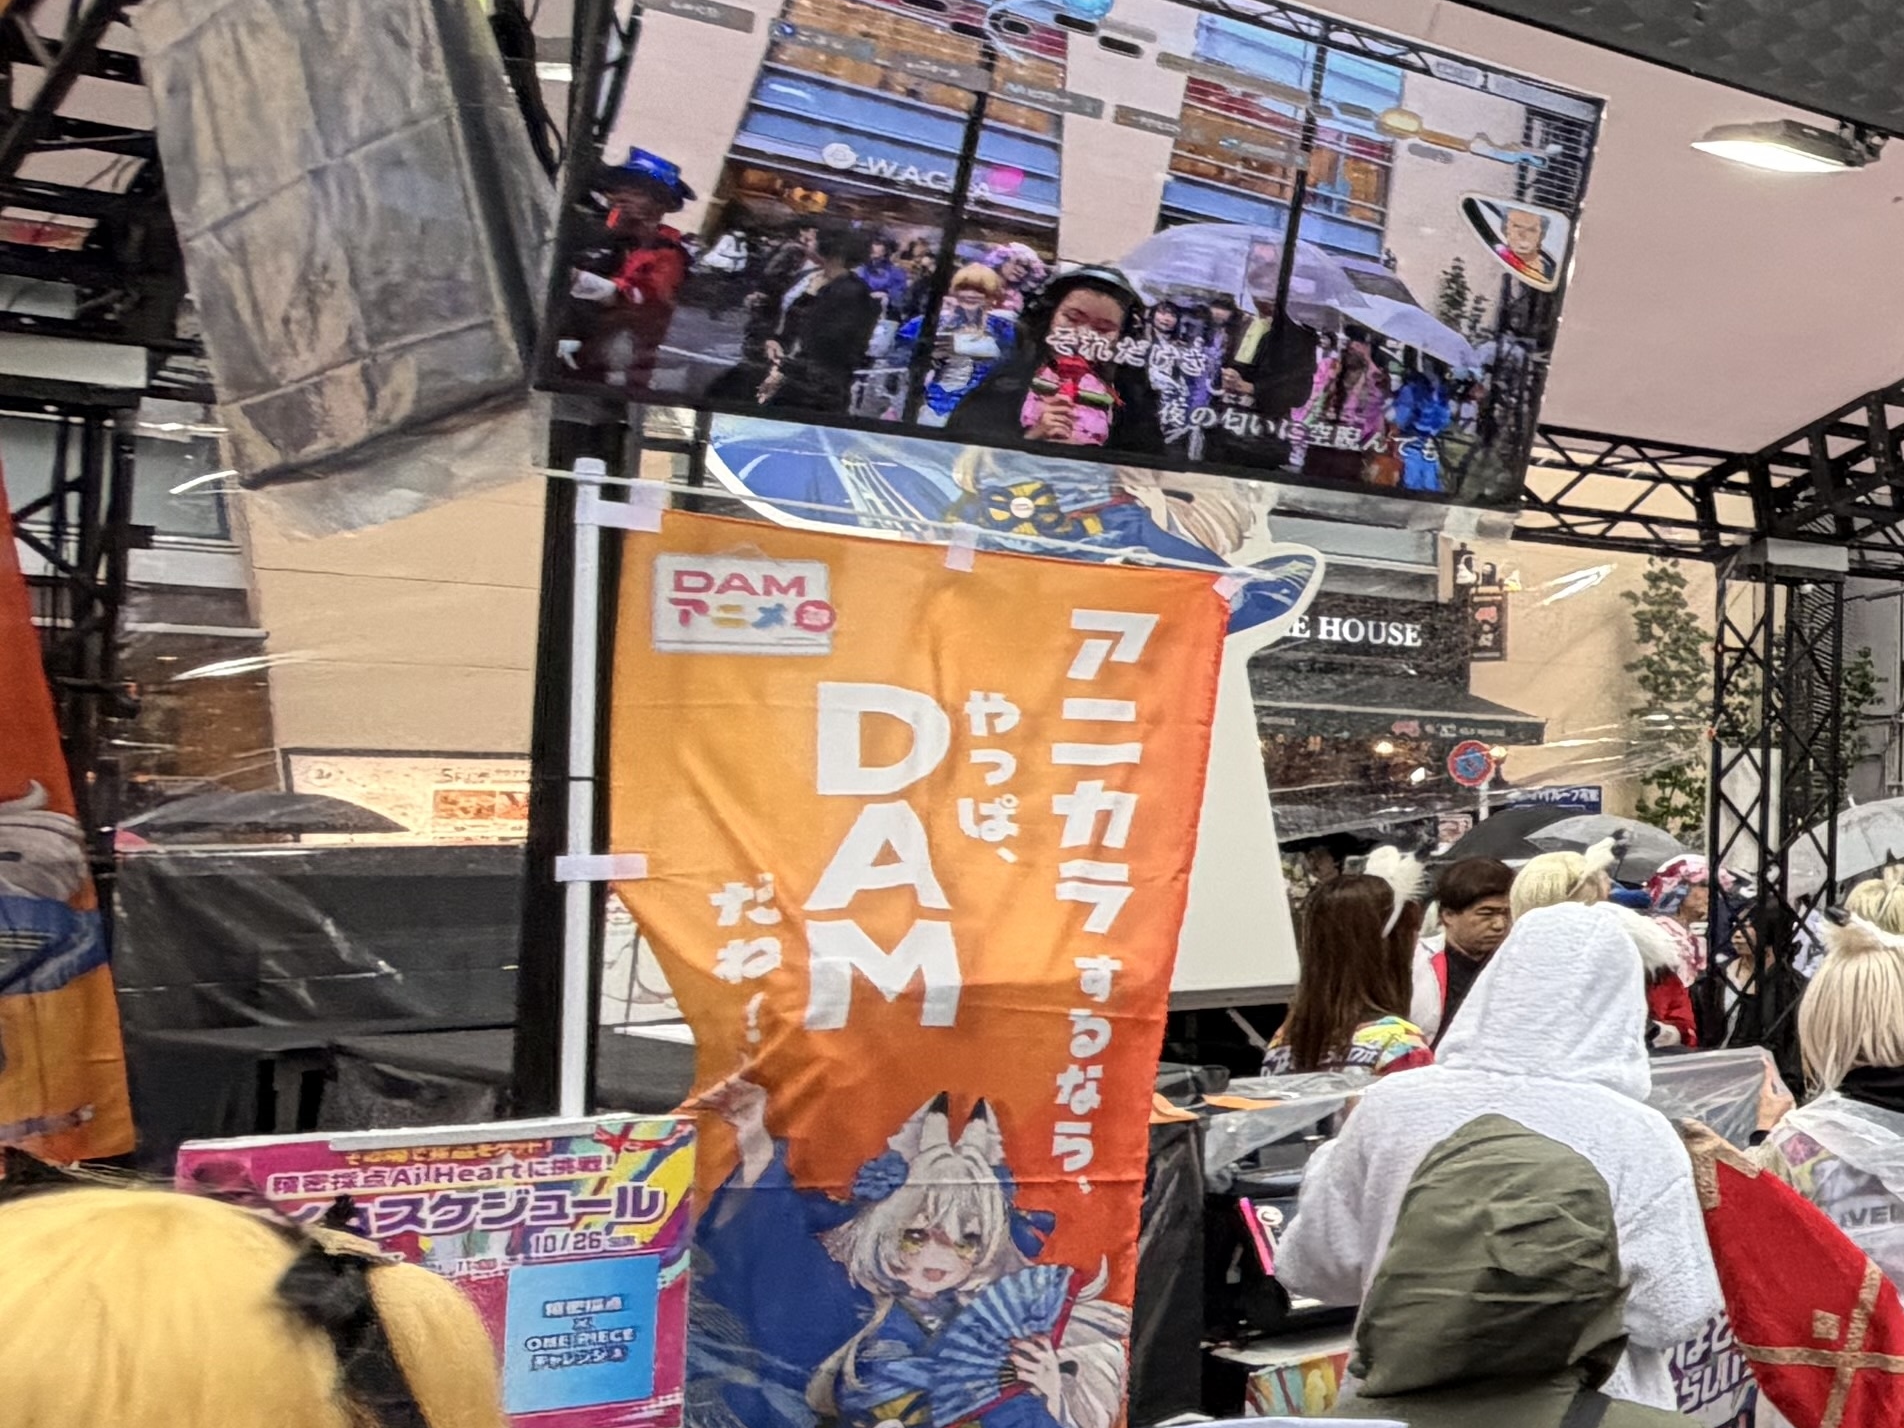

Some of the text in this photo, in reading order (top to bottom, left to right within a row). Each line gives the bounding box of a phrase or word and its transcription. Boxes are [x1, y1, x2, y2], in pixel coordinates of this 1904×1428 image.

[866, 155, 992, 200] WACA
[673, 570, 807, 597] DAM
[1318, 616, 1423, 648] HOUSE
[957, 690, 1021, 863] やっぱ、
[801, 680, 963, 1031] DAM
[300, 1183, 664, 1235] スケジュール
[531, 1231, 602, 1254] 10/26
[526, 1328, 634, 1351] ONE PIECE
